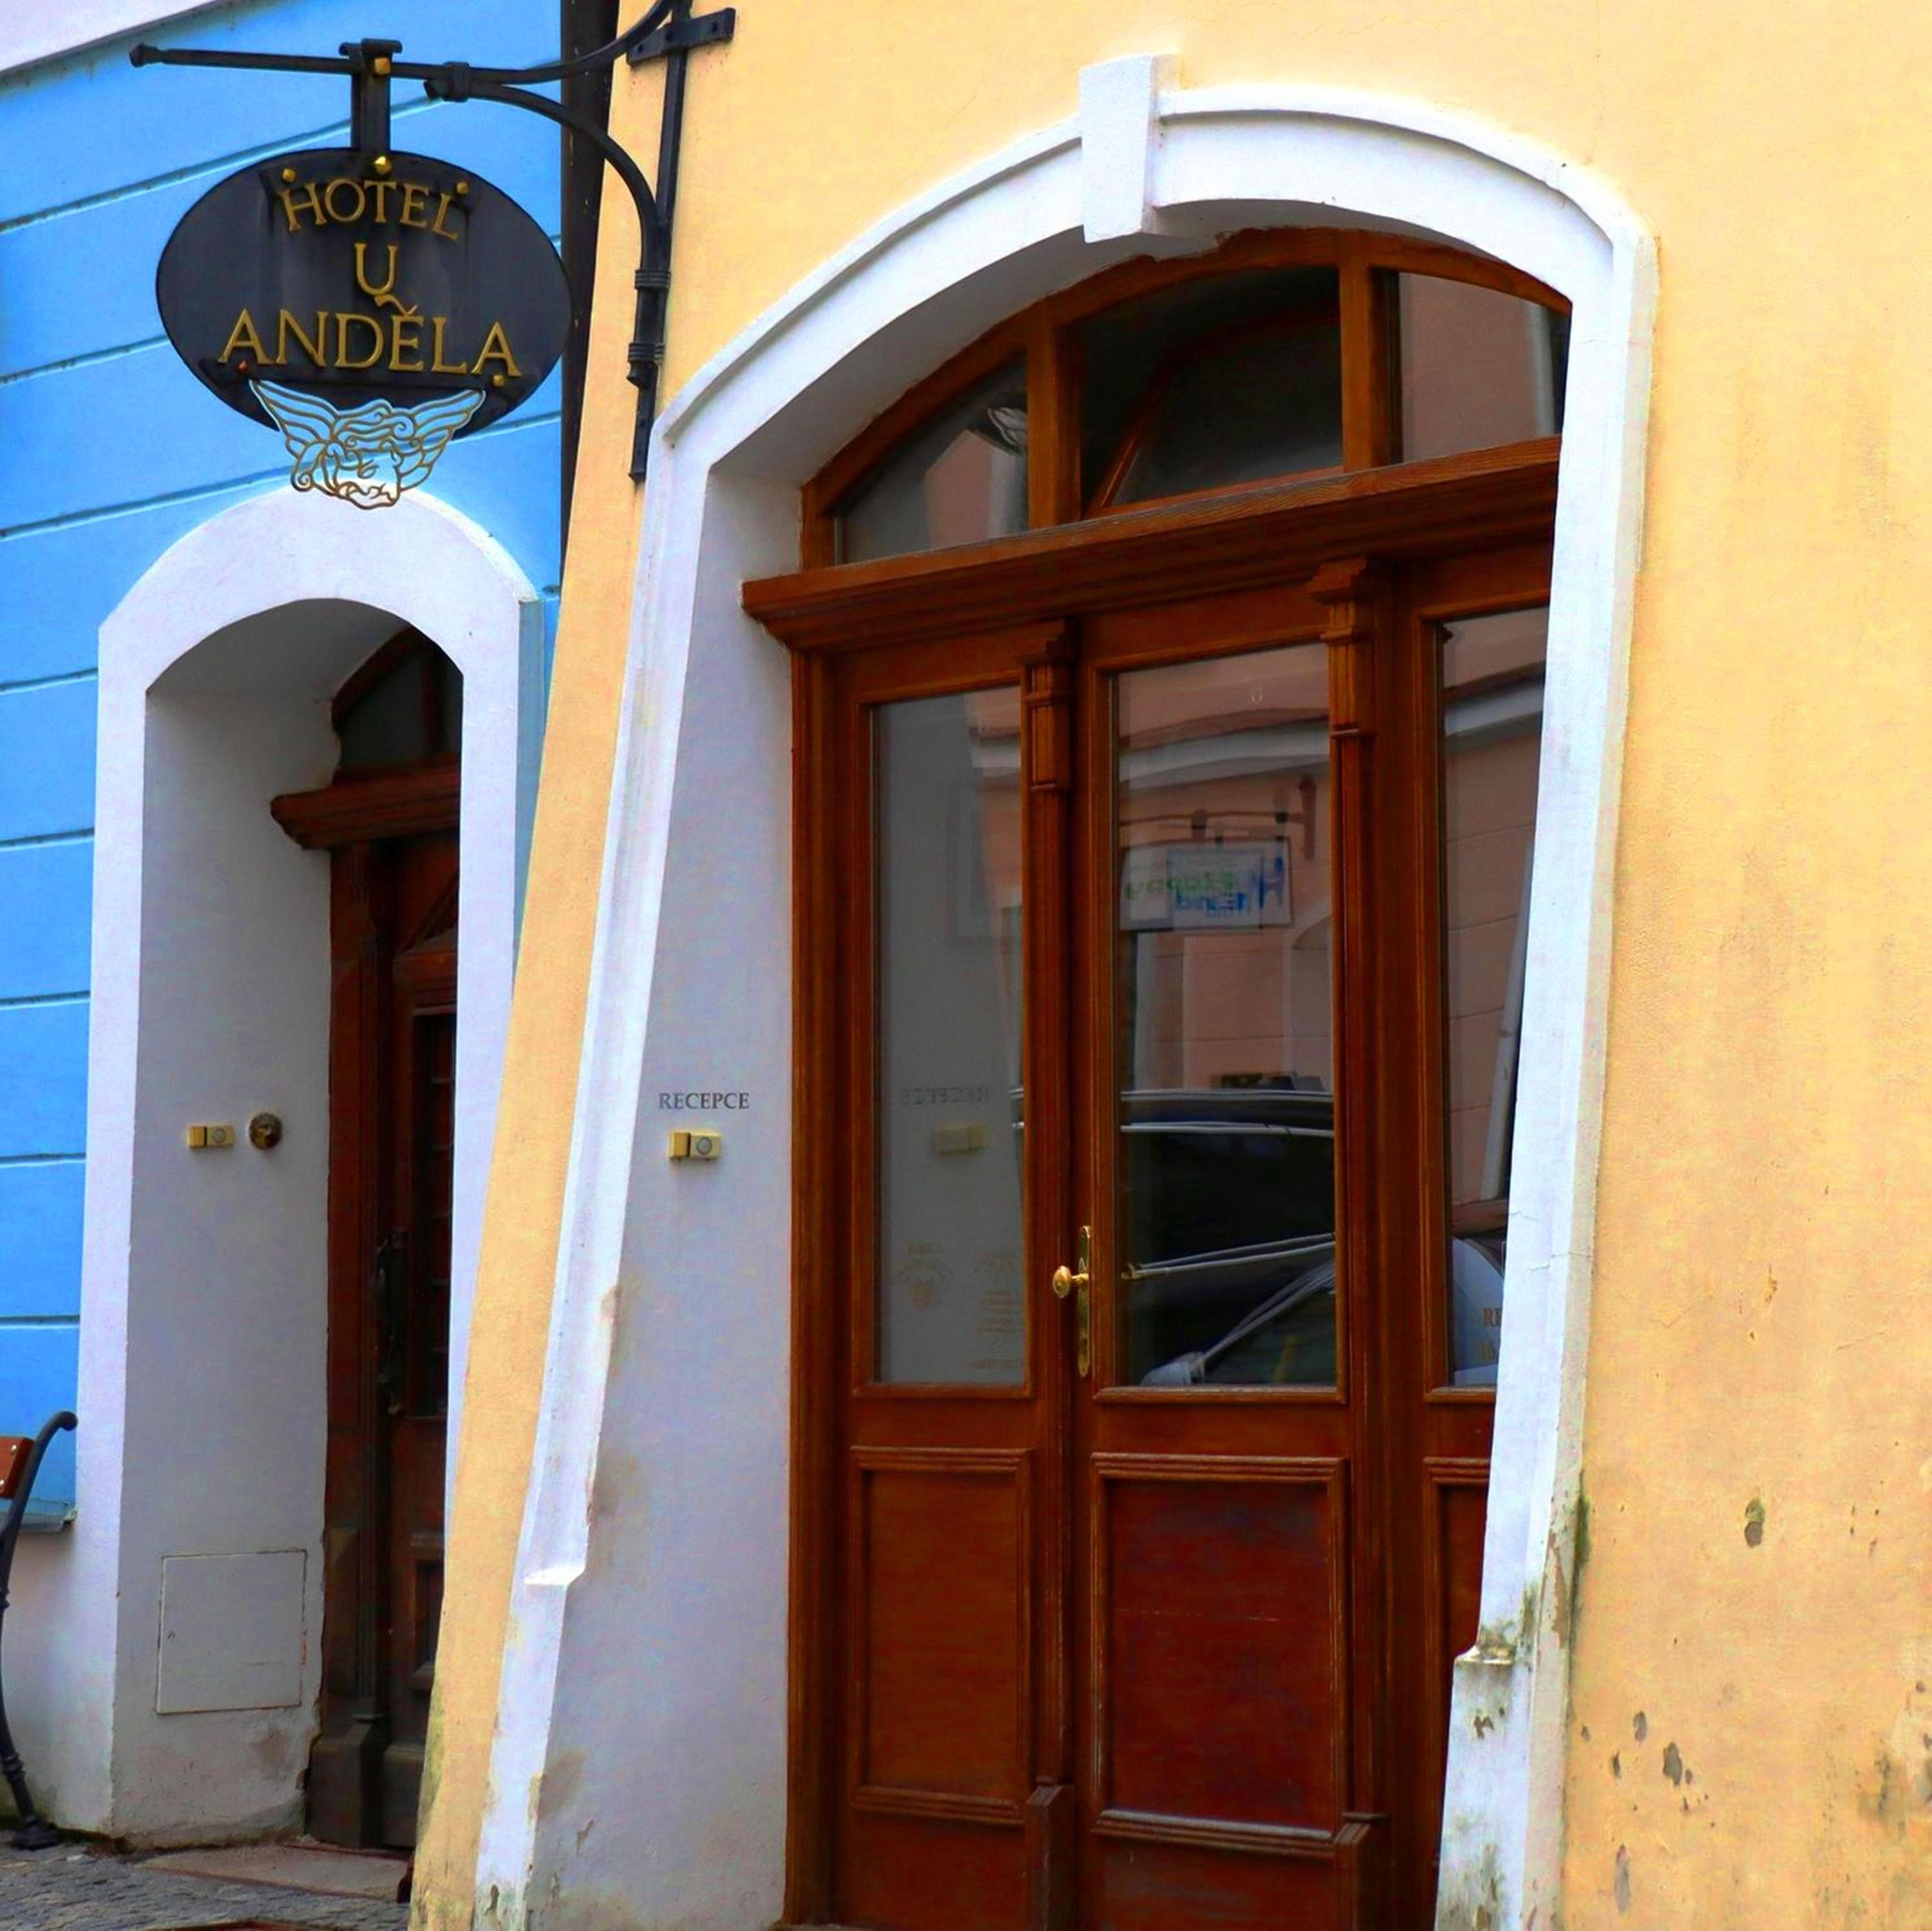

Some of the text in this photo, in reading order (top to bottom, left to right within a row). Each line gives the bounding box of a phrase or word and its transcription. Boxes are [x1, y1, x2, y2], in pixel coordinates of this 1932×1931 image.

[279, 178, 458, 240] HOTEL
[353, 242, 399, 296] U
[217, 305, 523, 377] ANDĚLA
[658, 1092, 750, 1110] RECEPCE
